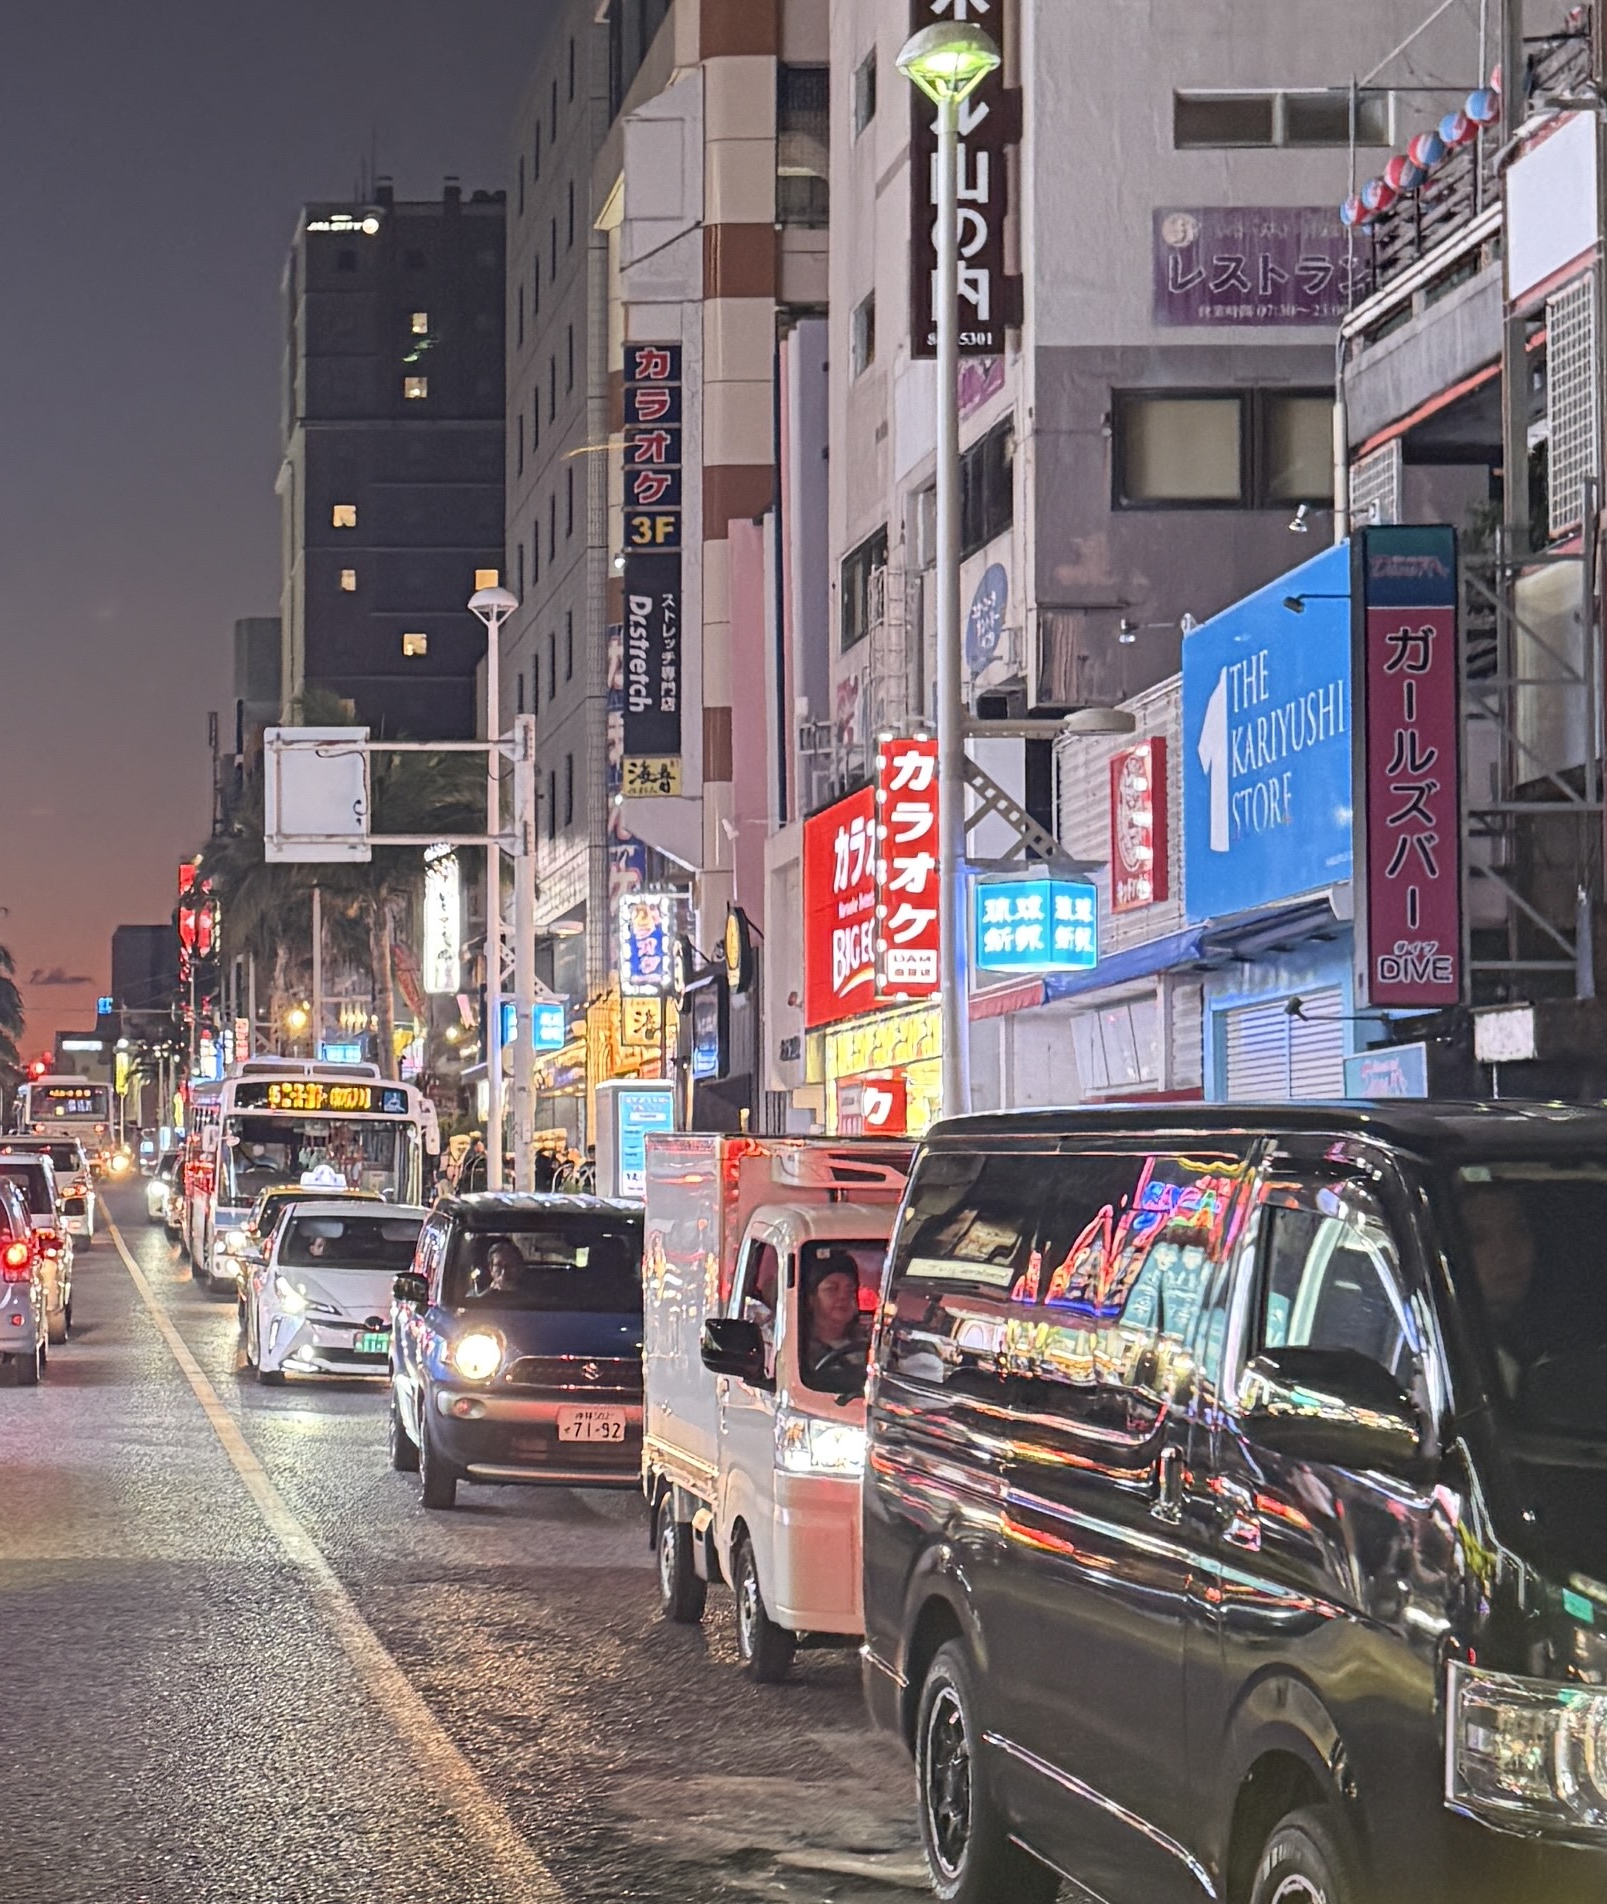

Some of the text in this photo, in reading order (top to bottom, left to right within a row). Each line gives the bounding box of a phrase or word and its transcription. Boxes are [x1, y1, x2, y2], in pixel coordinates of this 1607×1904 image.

[1169, 254, 1372, 294] レストラン
[634, 347, 674, 507] カラオケ
[631, 516, 674, 546] 3F
[1229, 649, 1269, 712] THE
[1231, 681, 1346, 777] KARIYUSHI
[1385, 627, 1438, 929] ガールズバー
[889, 751, 938, 944] カラオケ
[1378, 955, 1454, 983] DIVE
